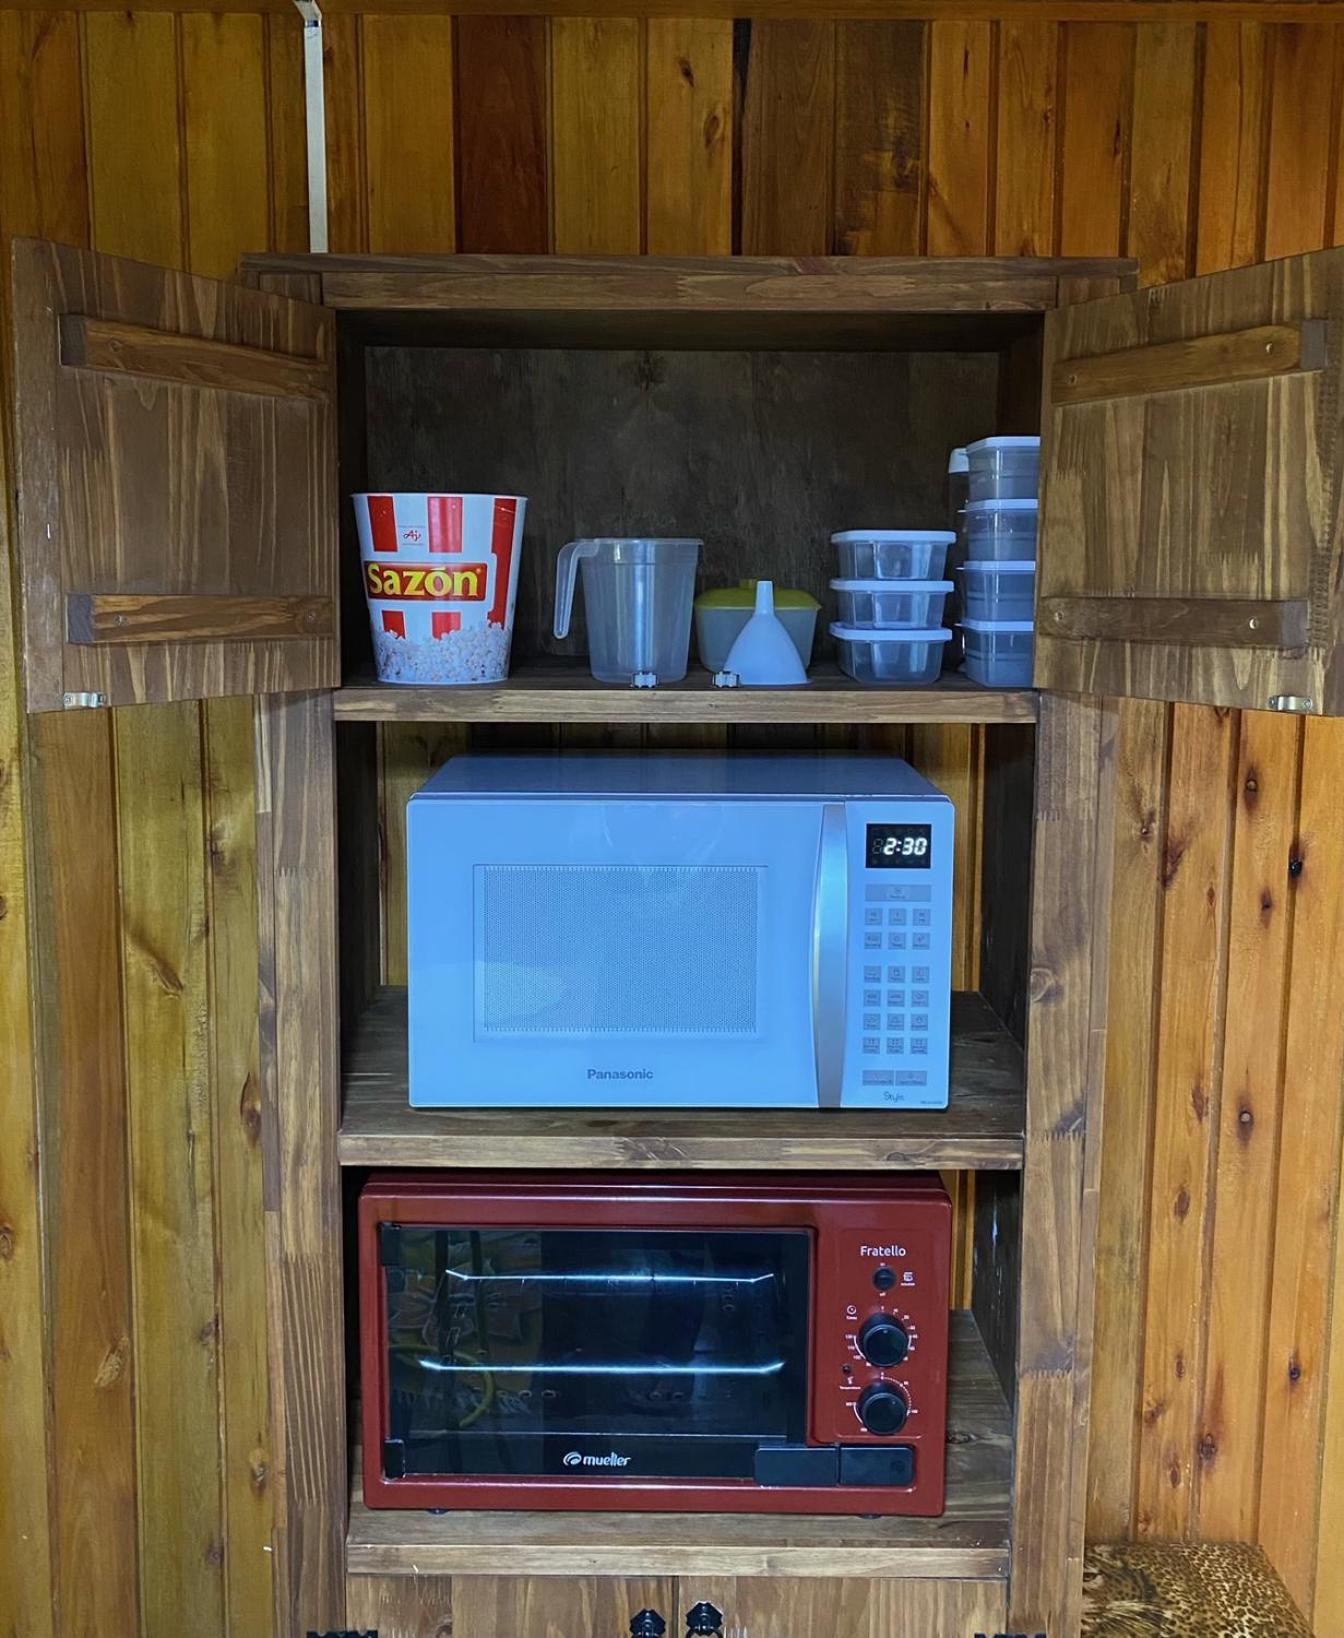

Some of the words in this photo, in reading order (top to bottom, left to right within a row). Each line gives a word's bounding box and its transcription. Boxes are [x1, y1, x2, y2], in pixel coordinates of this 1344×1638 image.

[367, 563, 478, 597] Sazón
[883, 837, 927, 855] 2:30
[587, 1068, 654, 1080] Panasonic
[860, 1245, 906, 1256] Fratello
[583, 1452, 631, 1466] mueller
